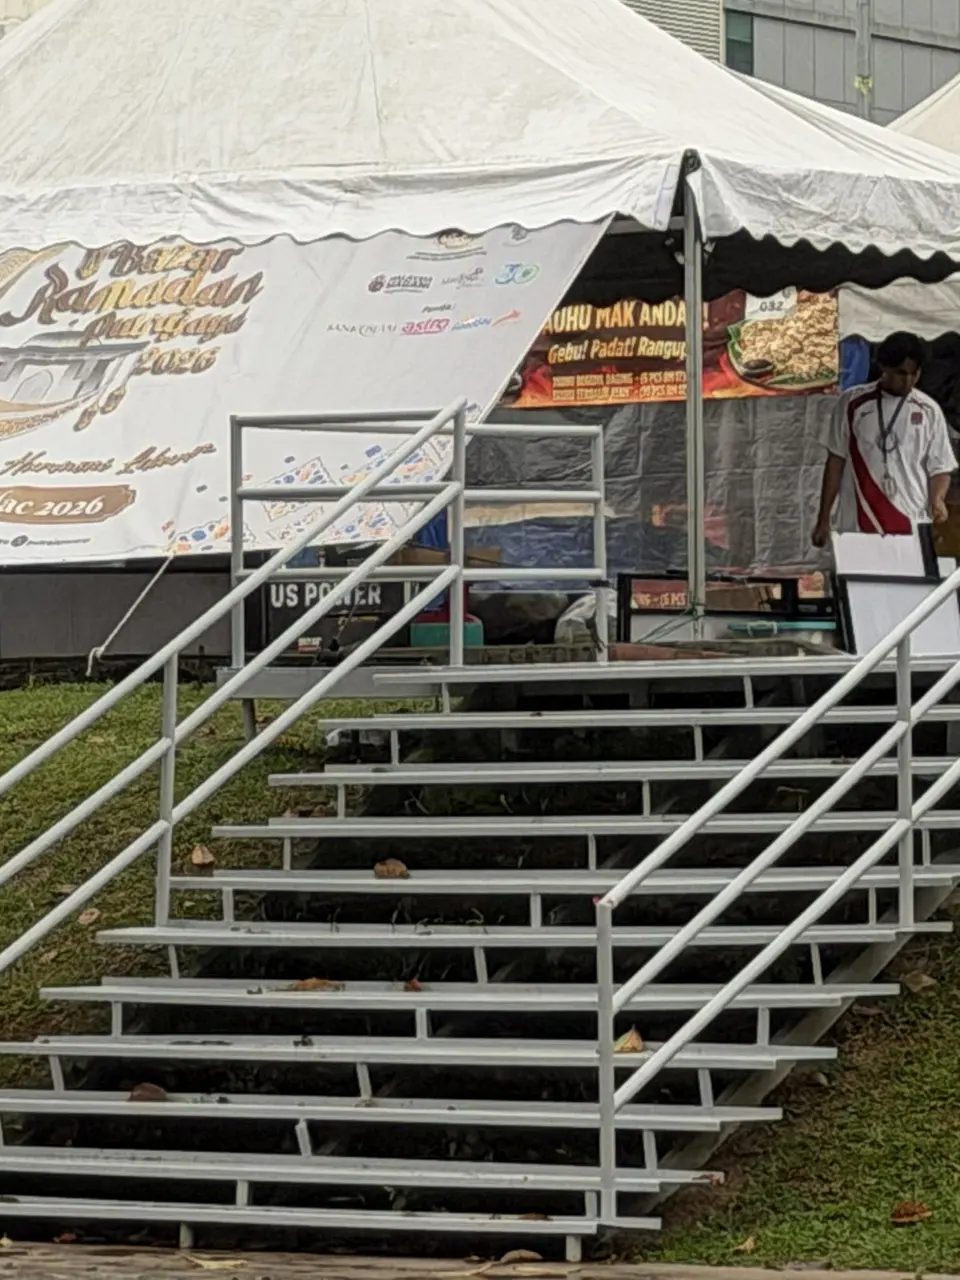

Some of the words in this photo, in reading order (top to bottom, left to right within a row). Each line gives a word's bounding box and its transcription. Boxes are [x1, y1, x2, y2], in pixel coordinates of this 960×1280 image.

[130, 346, 221, 375] 2026
[33, 495, 106, 517] 2026
[270, 583, 299, 608] US
